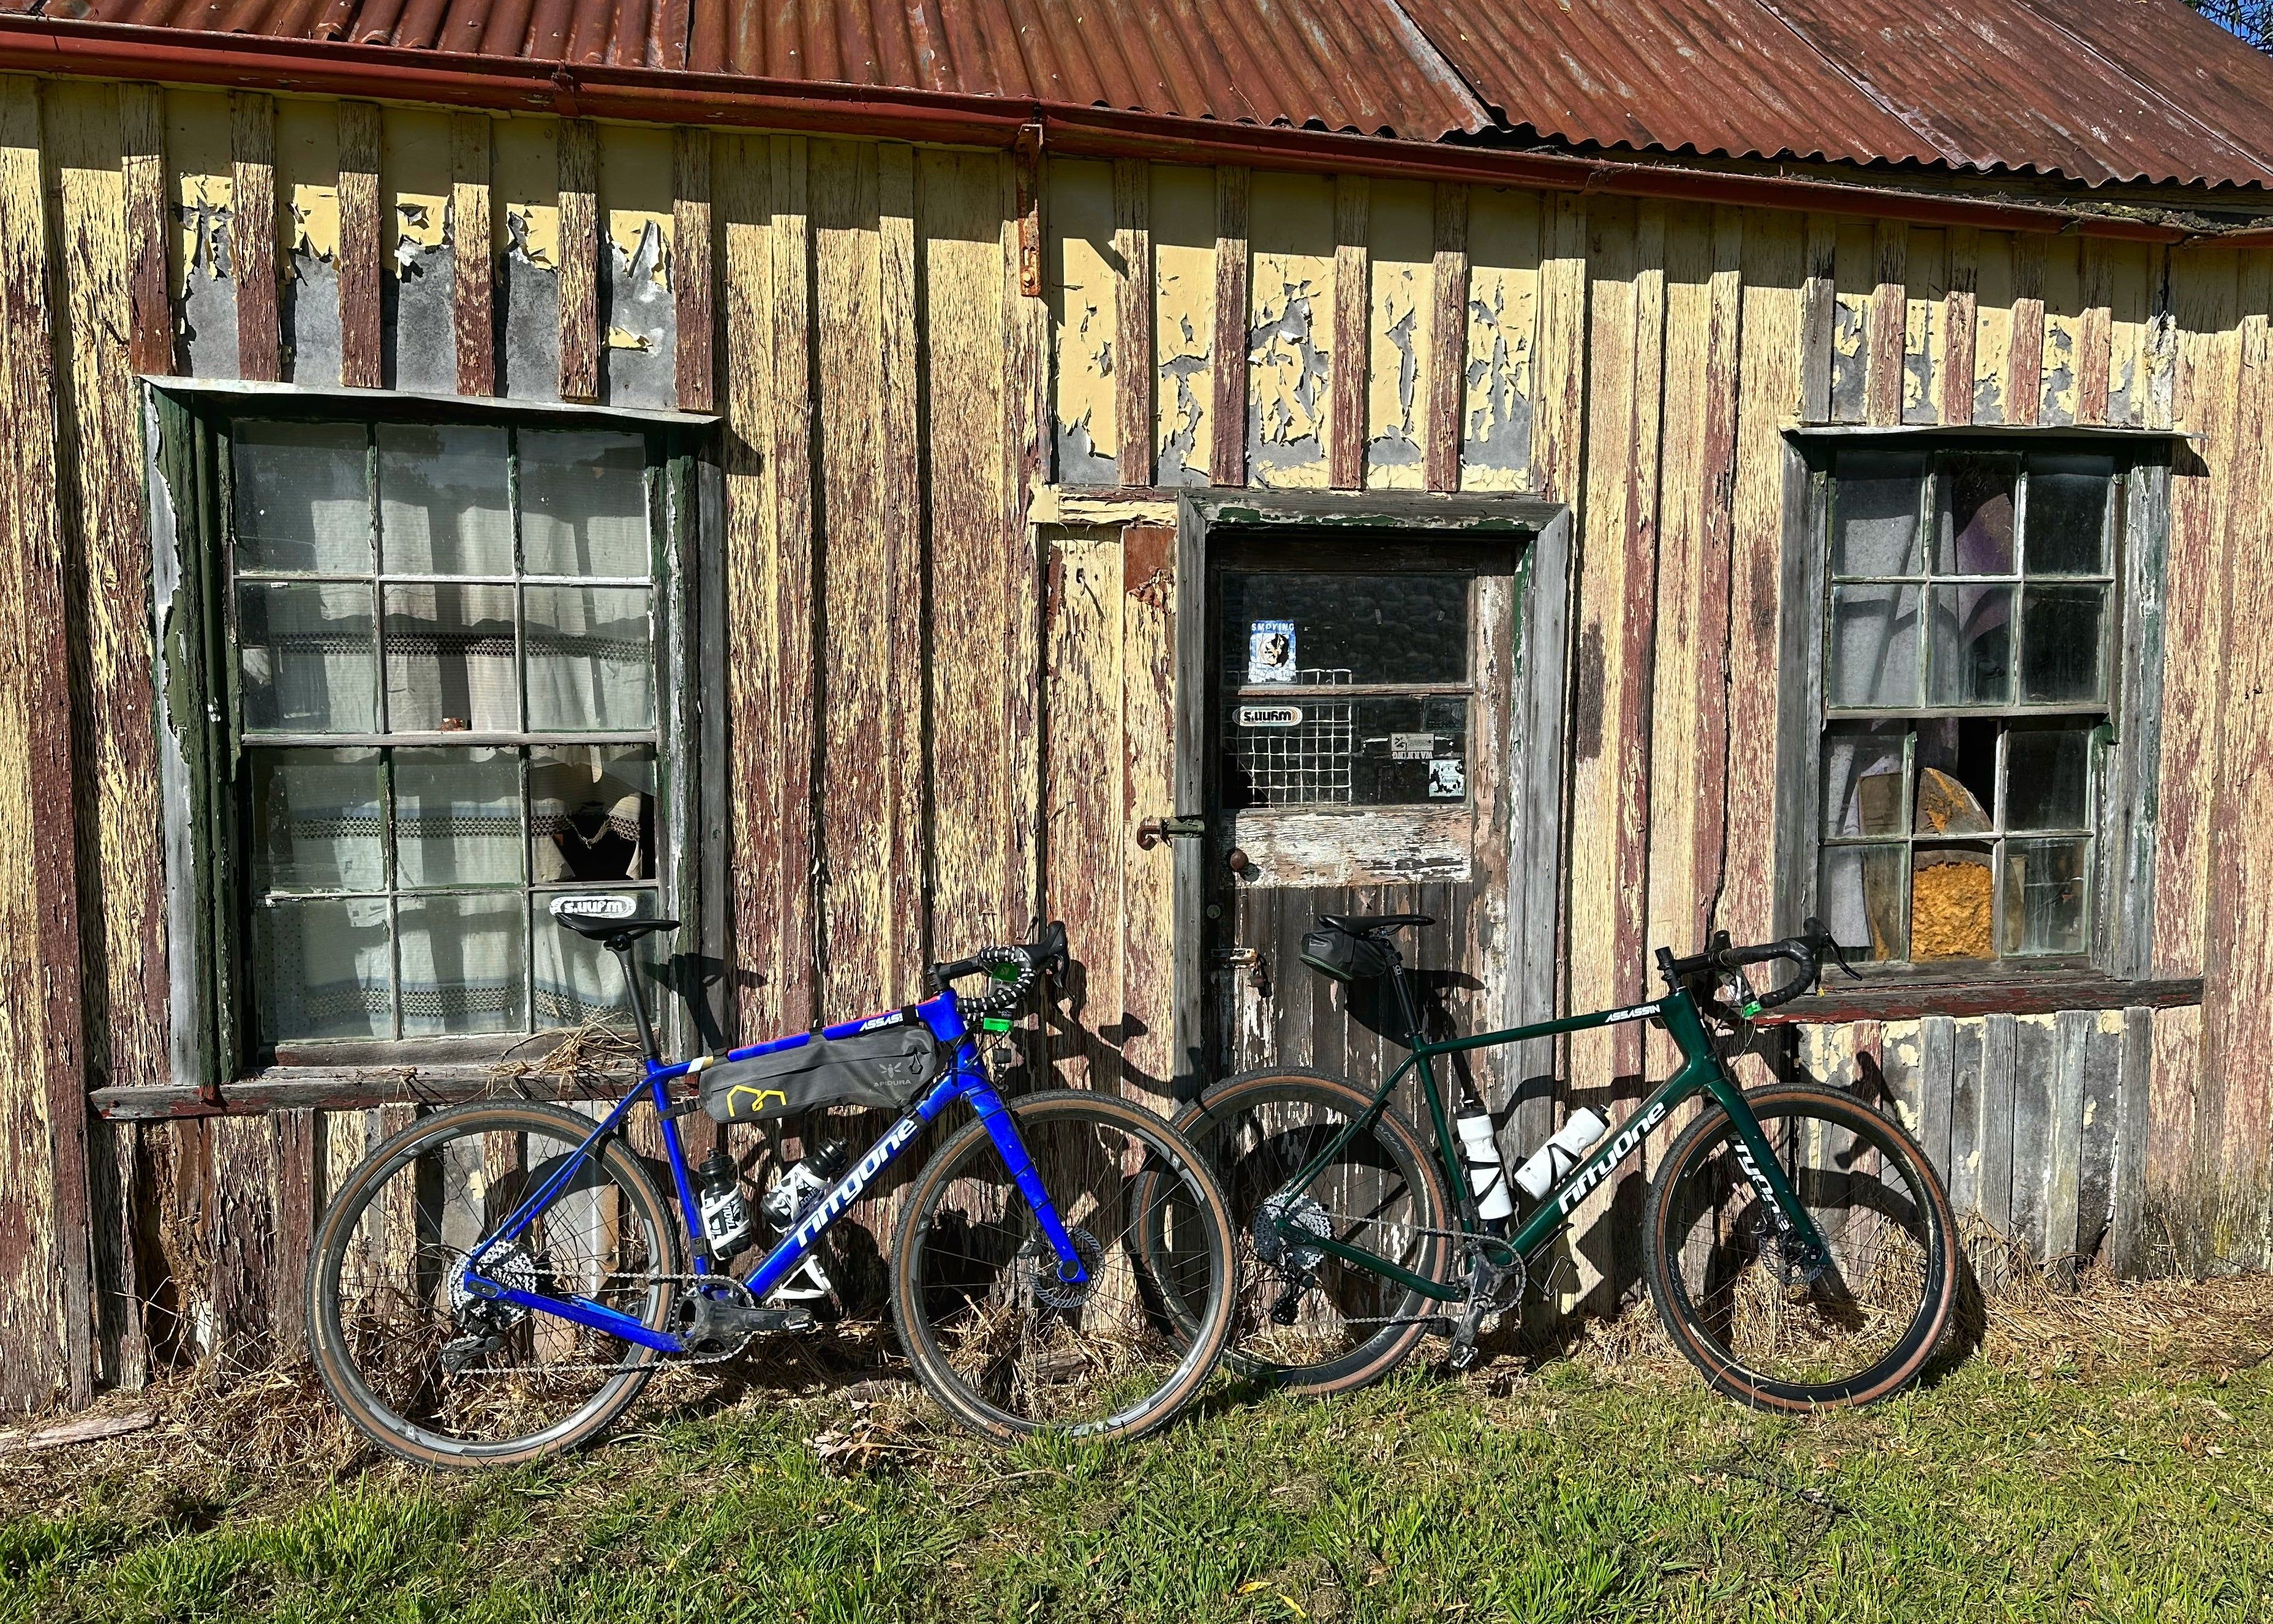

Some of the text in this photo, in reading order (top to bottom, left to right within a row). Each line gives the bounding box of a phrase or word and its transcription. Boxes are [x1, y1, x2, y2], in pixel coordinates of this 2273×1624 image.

[1392, 751, 1433, 760] WARNING
[1605, 1004, 1660, 1023] ASSASSIN
[873, 1079, 912, 1088] APIDURA
[1938, 1199, 1953, 1238] PIRELLI
